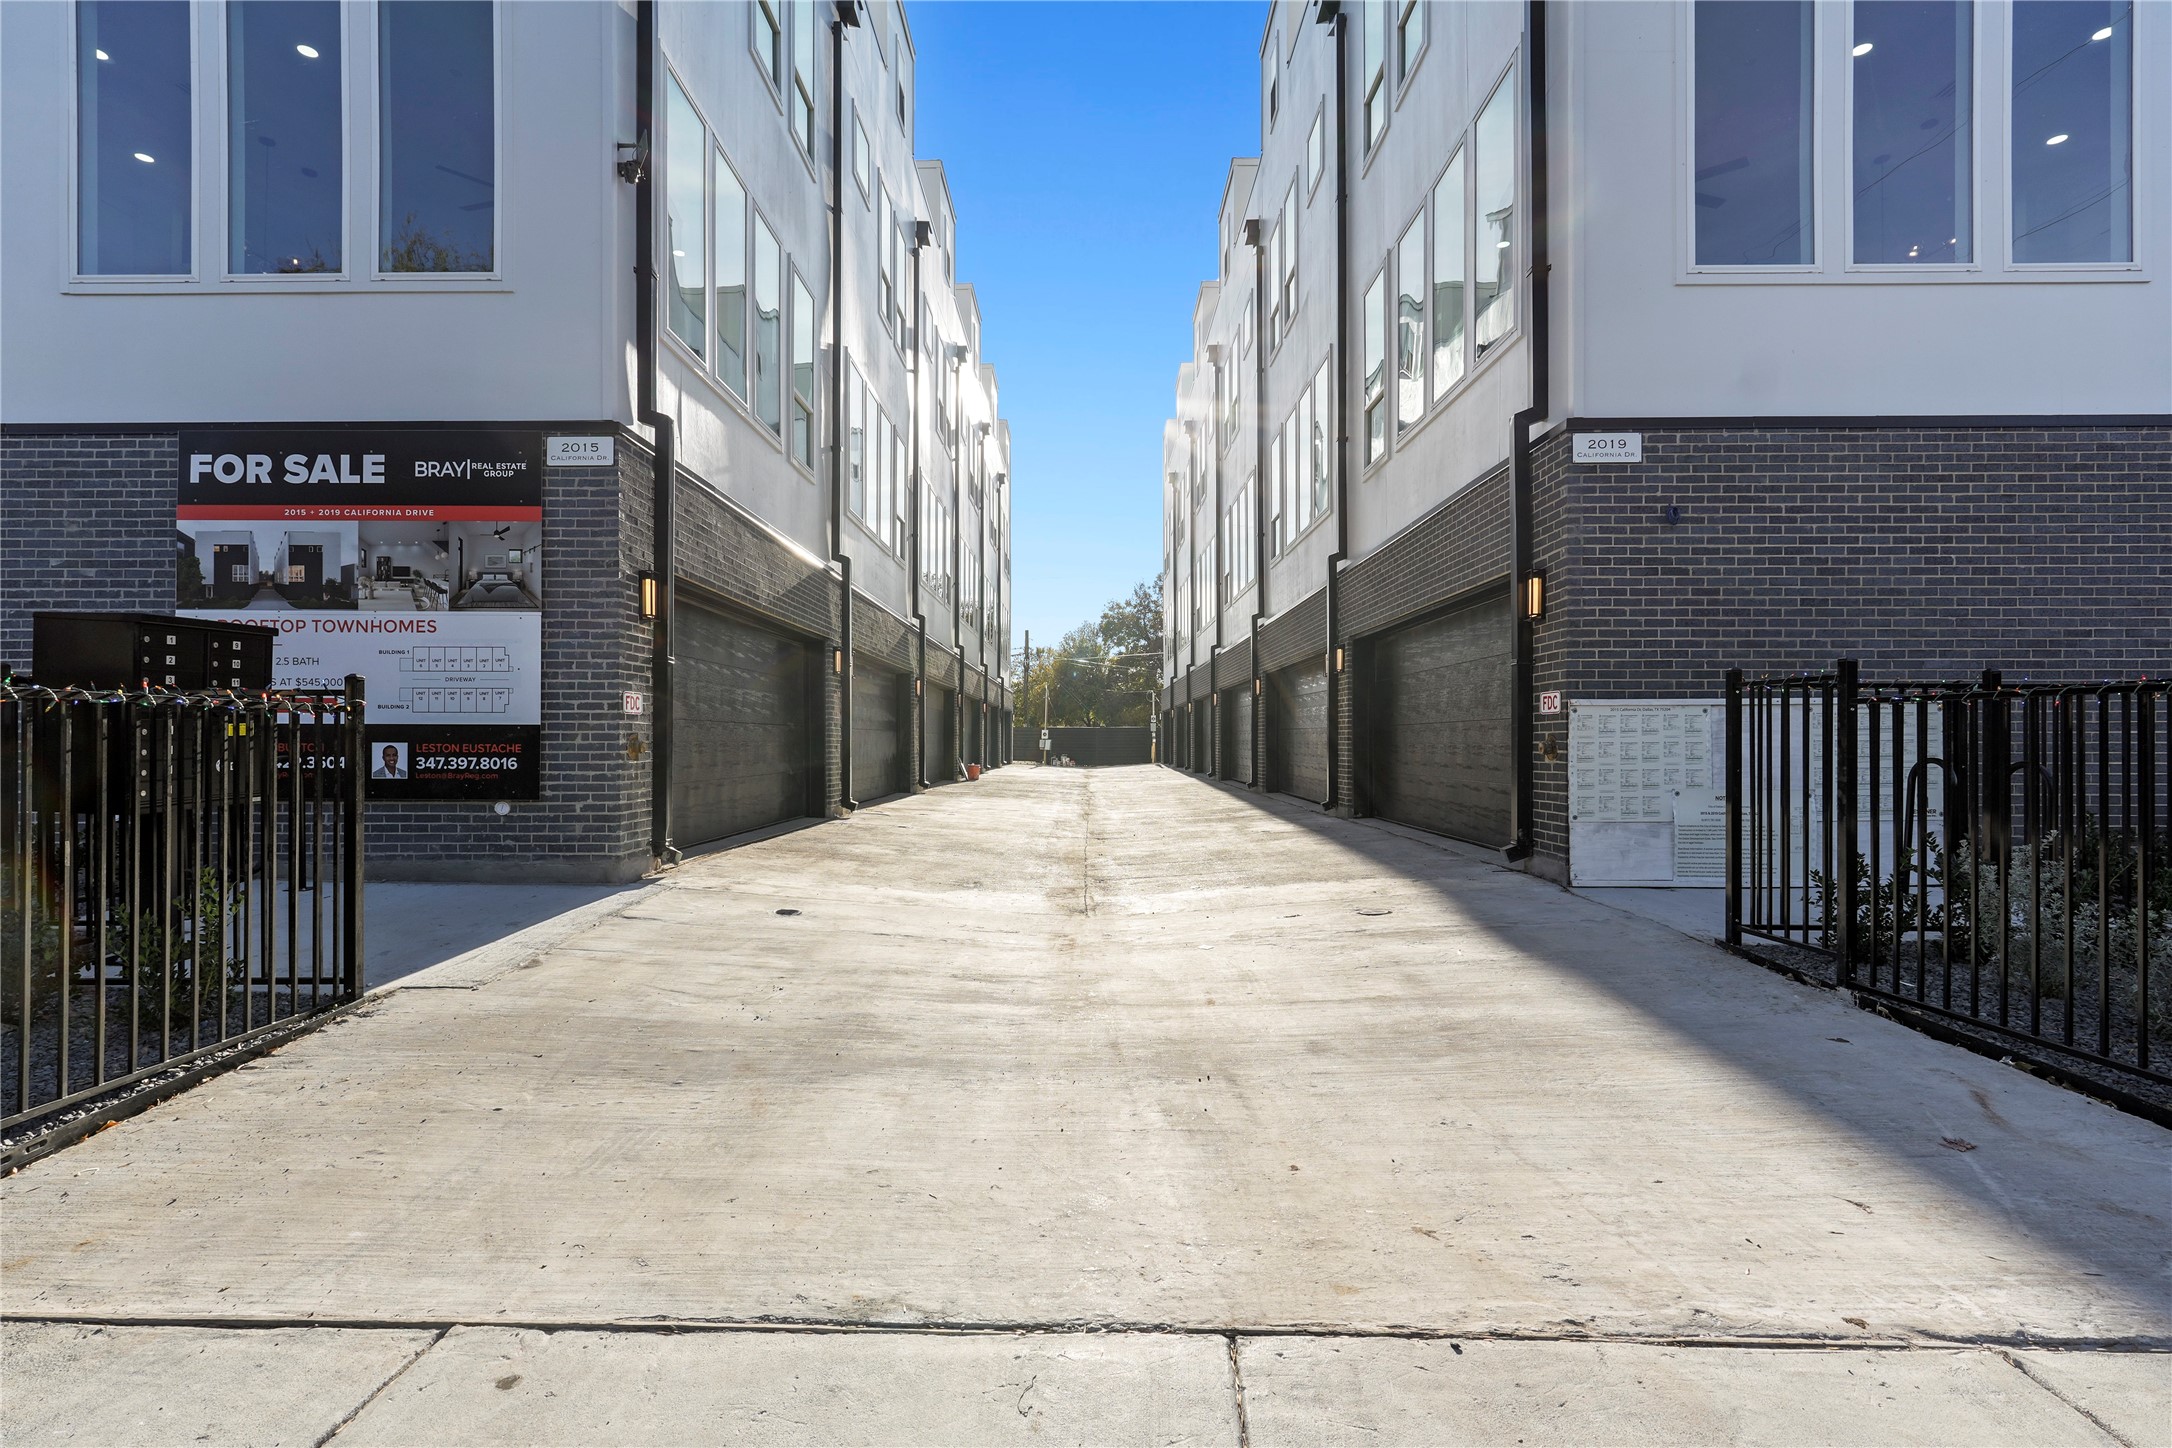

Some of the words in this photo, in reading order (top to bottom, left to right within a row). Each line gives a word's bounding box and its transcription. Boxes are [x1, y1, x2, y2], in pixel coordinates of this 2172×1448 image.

[561, 442, 599, 453] 2015
[1588, 439, 1627, 450] 2019
[189, 453, 273, 484] FOR
[283, 453, 386, 484] SALE
[414, 461, 466, 478] BRAY
[471, 462, 494, 470] REAL
[496, 462, 527, 470] ESTATE
[483, 470, 515, 478] GROUP
[284, 508, 307, 516] 2015
[318, 508, 341, 516] 2019
[344, 508, 402, 516] CALIFORNIA
[312, 619, 437, 633] TOWNHOMES
[234, 641, 239, 649] 9
[233, 660, 240, 668] 10
[275, 657, 289, 666] 2.5
[292, 657, 320, 666] BATH
[232, 678, 240, 686] 11
[280, 678, 292, 686] AT
[625, 695, 640, 711] FDC
[1542, 695, 1558, 711] FDC
[416, 743, 460, 753] LESTON
[463, 743, 522, 753] EUSTACHE
[416, 757, 518, 770] 347.397.8016
